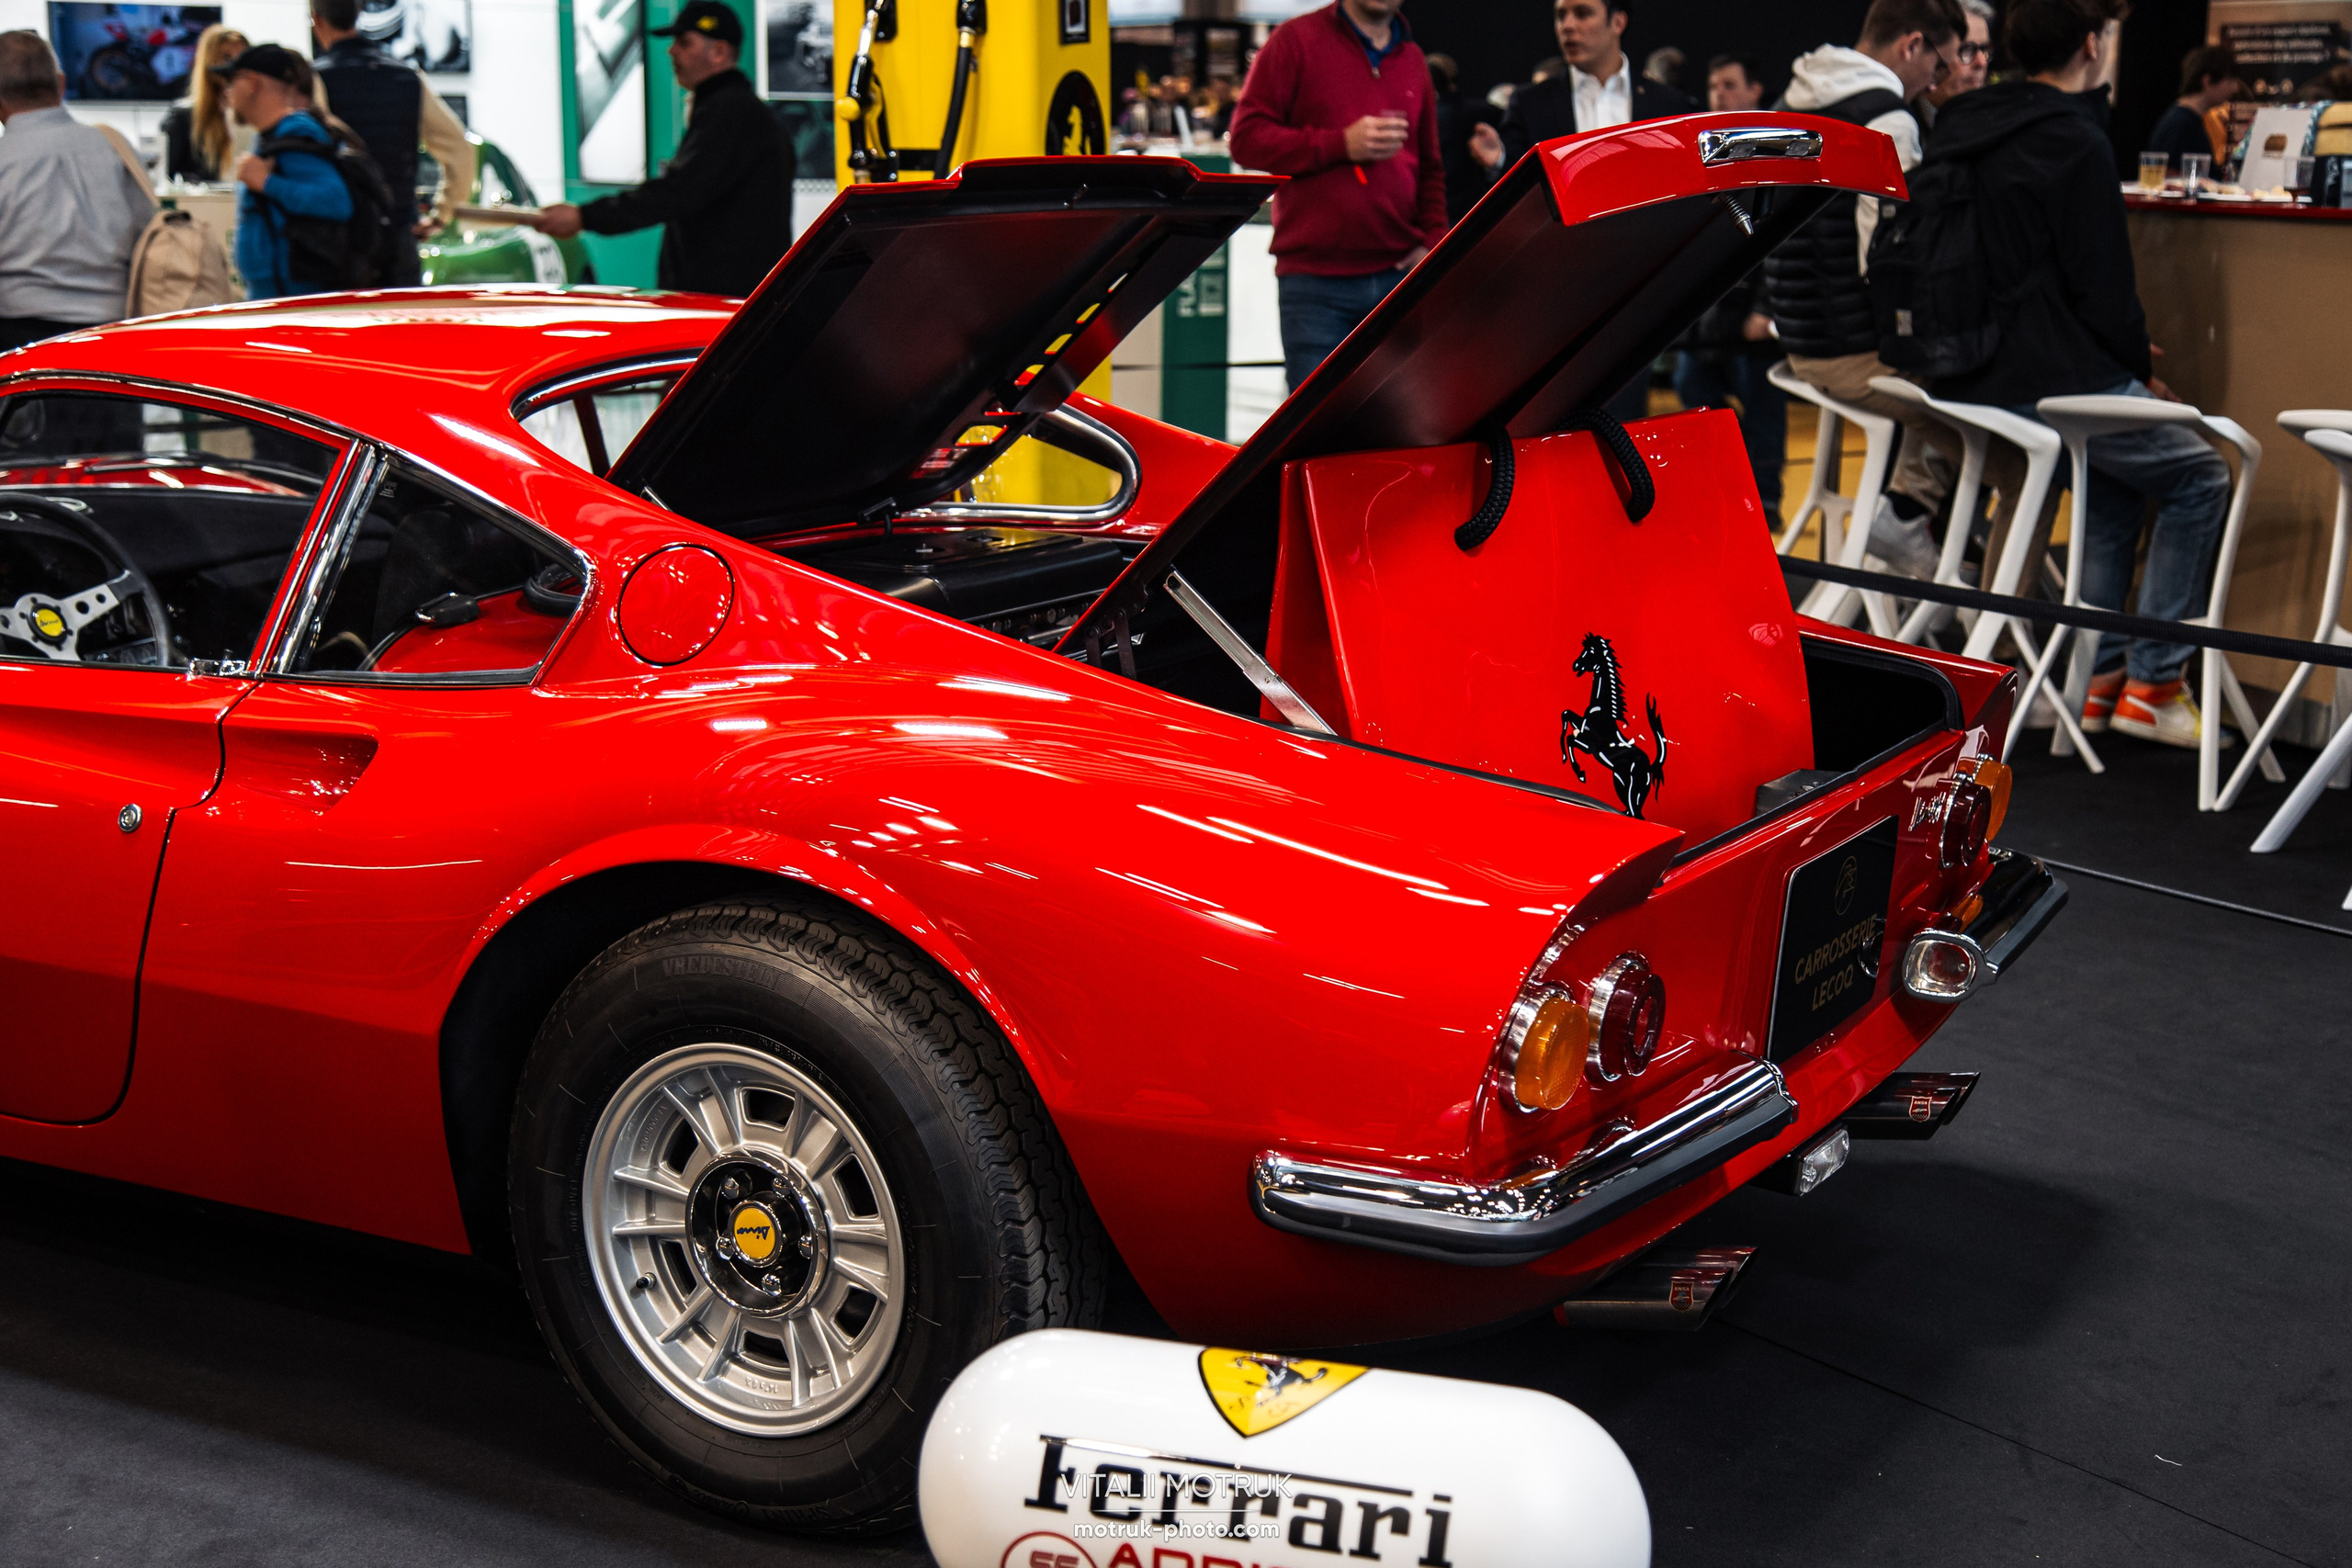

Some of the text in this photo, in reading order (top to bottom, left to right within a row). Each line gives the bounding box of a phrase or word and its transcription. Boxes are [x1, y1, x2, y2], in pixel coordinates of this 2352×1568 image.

[662, 954, 781, 991] VREDESTEIN
[1794, 913, 1878, 985] CARROSSERIE
[1811, 964, 1854, 1011] LECOQ
[737, 1225, 771, 1241] Dino
[1023, 1434, 1453, 1568] Ferrari
